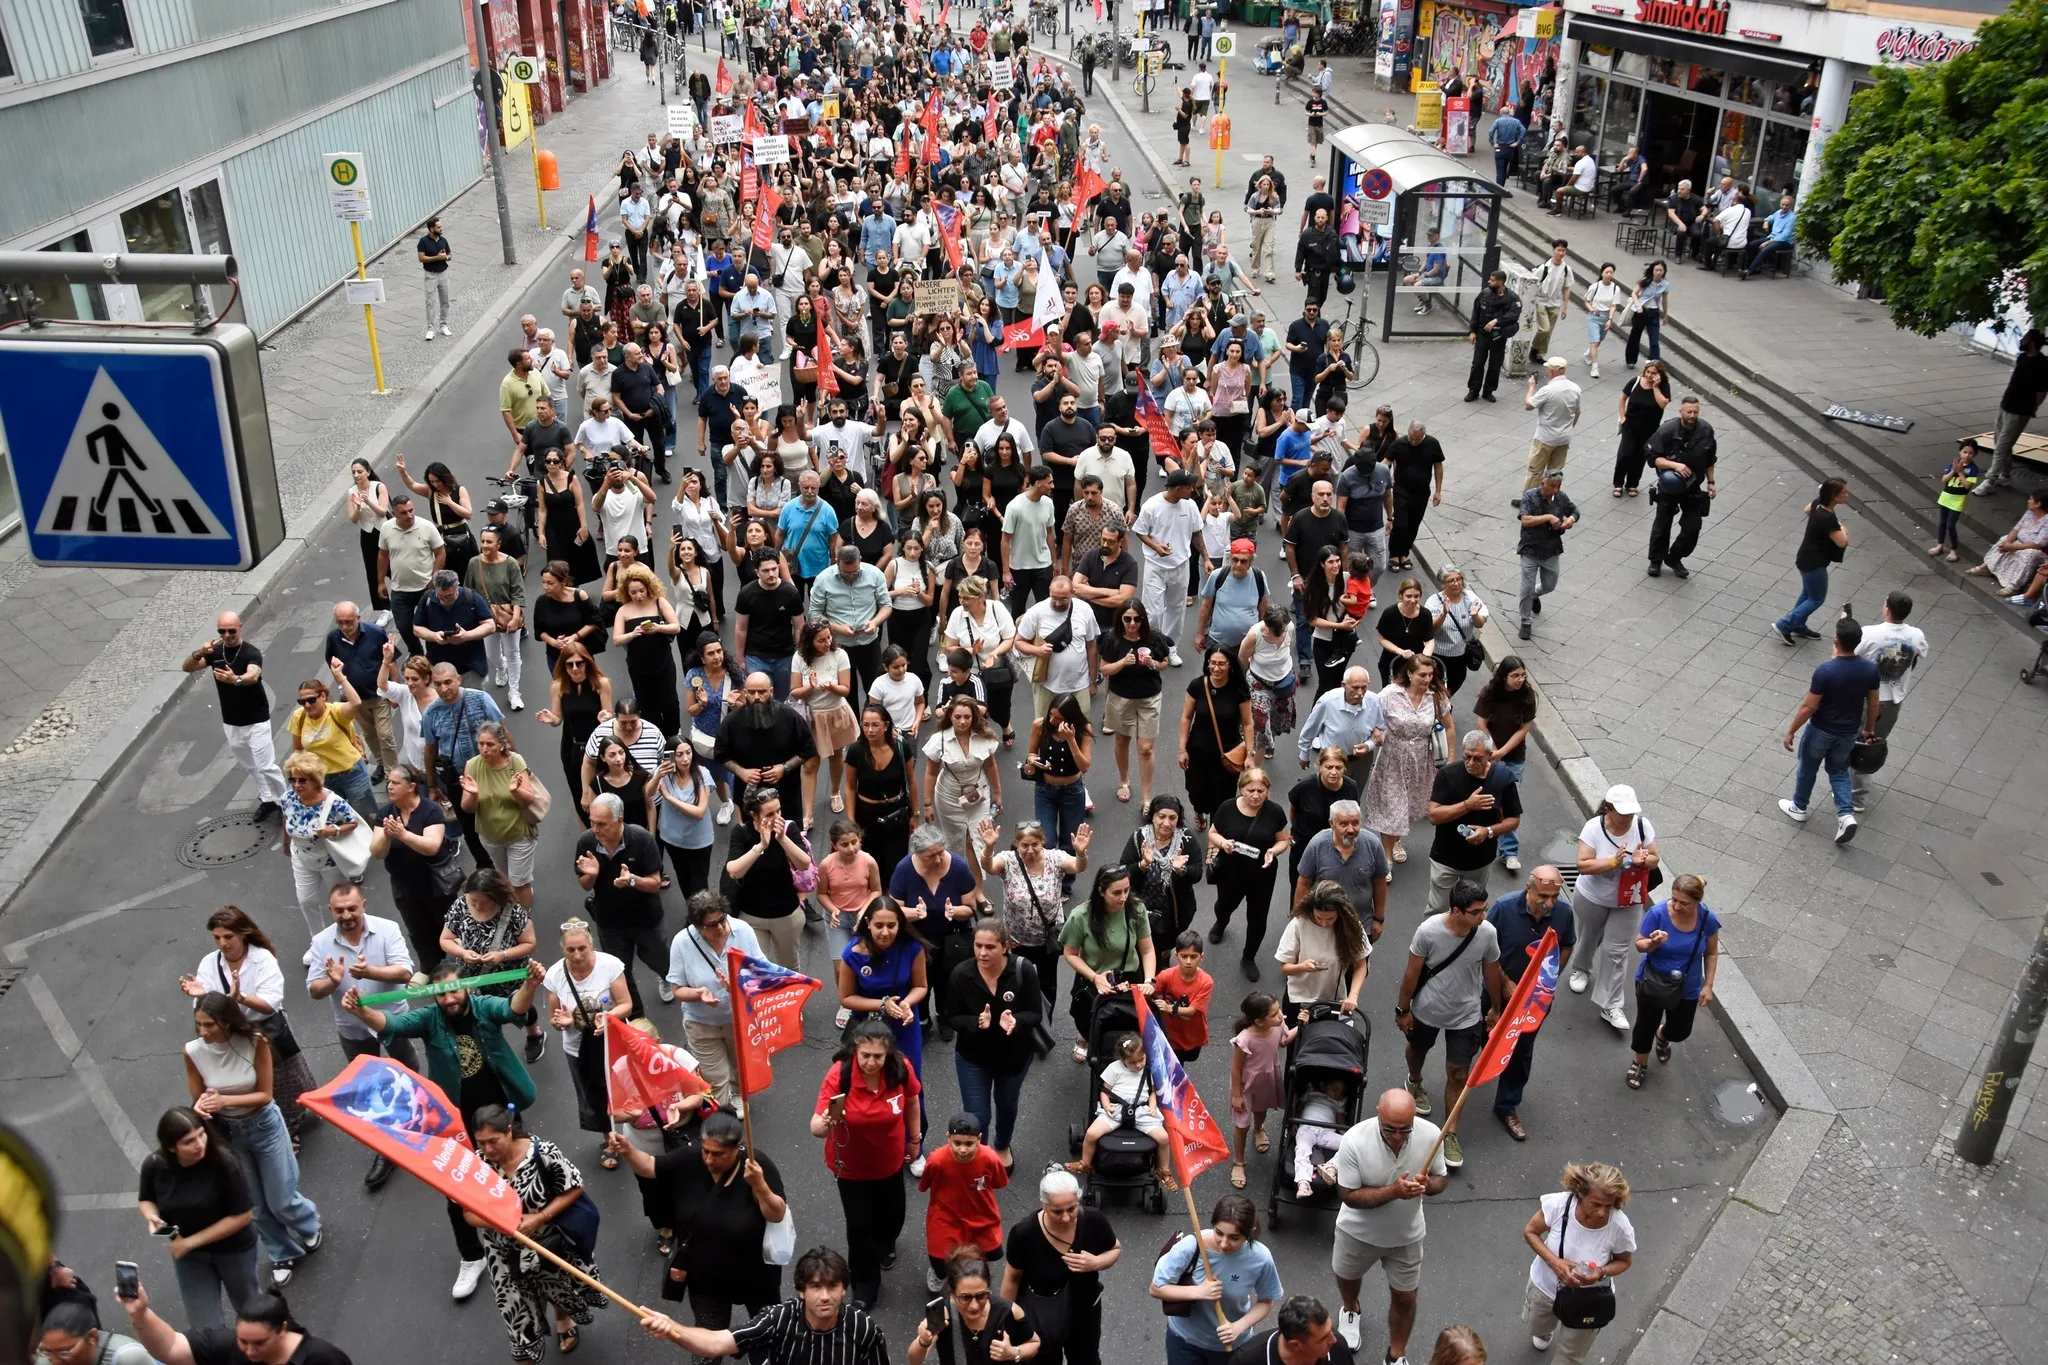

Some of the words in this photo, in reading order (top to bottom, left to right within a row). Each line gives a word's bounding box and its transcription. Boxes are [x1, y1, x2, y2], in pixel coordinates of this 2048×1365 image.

[1536, 24, 1552, 34] BVG
[519, 66, 528, 75] H
[337, 165, 350, 180] H
[1363, 202, 1386, 210] Einsatz-
[914, 281, 941, 289] UNSERE
[928, 287, 956, 295] LICHTER
